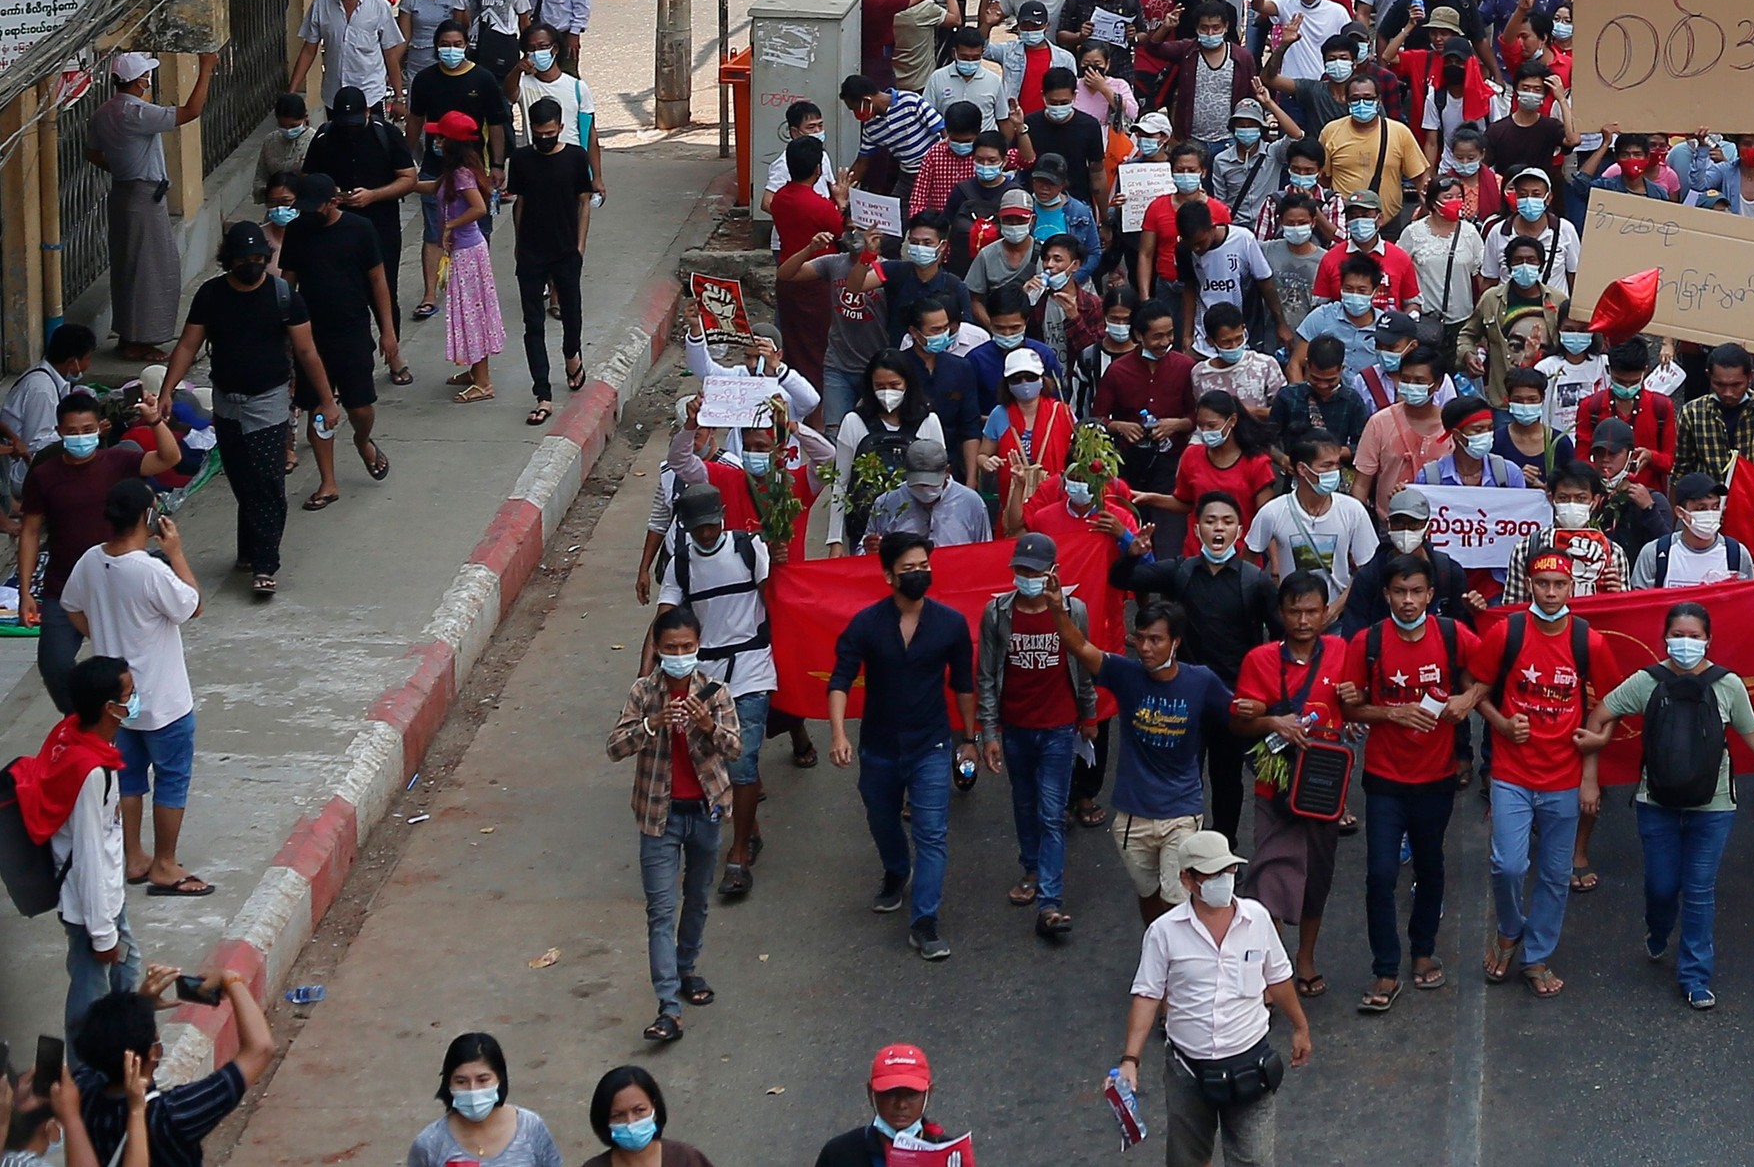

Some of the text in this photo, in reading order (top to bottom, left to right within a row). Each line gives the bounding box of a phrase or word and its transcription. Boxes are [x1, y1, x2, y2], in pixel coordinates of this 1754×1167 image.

[856, 199, 889, 212] WE DON'T
[863, 209, 883, 218] WANT
[857, 216, 892, 228] MILITARY
[1203, 278, 1236, 293] Jeep
[845, 292, 860, 304] 34
[1019, 652, 1049, 669] NY
